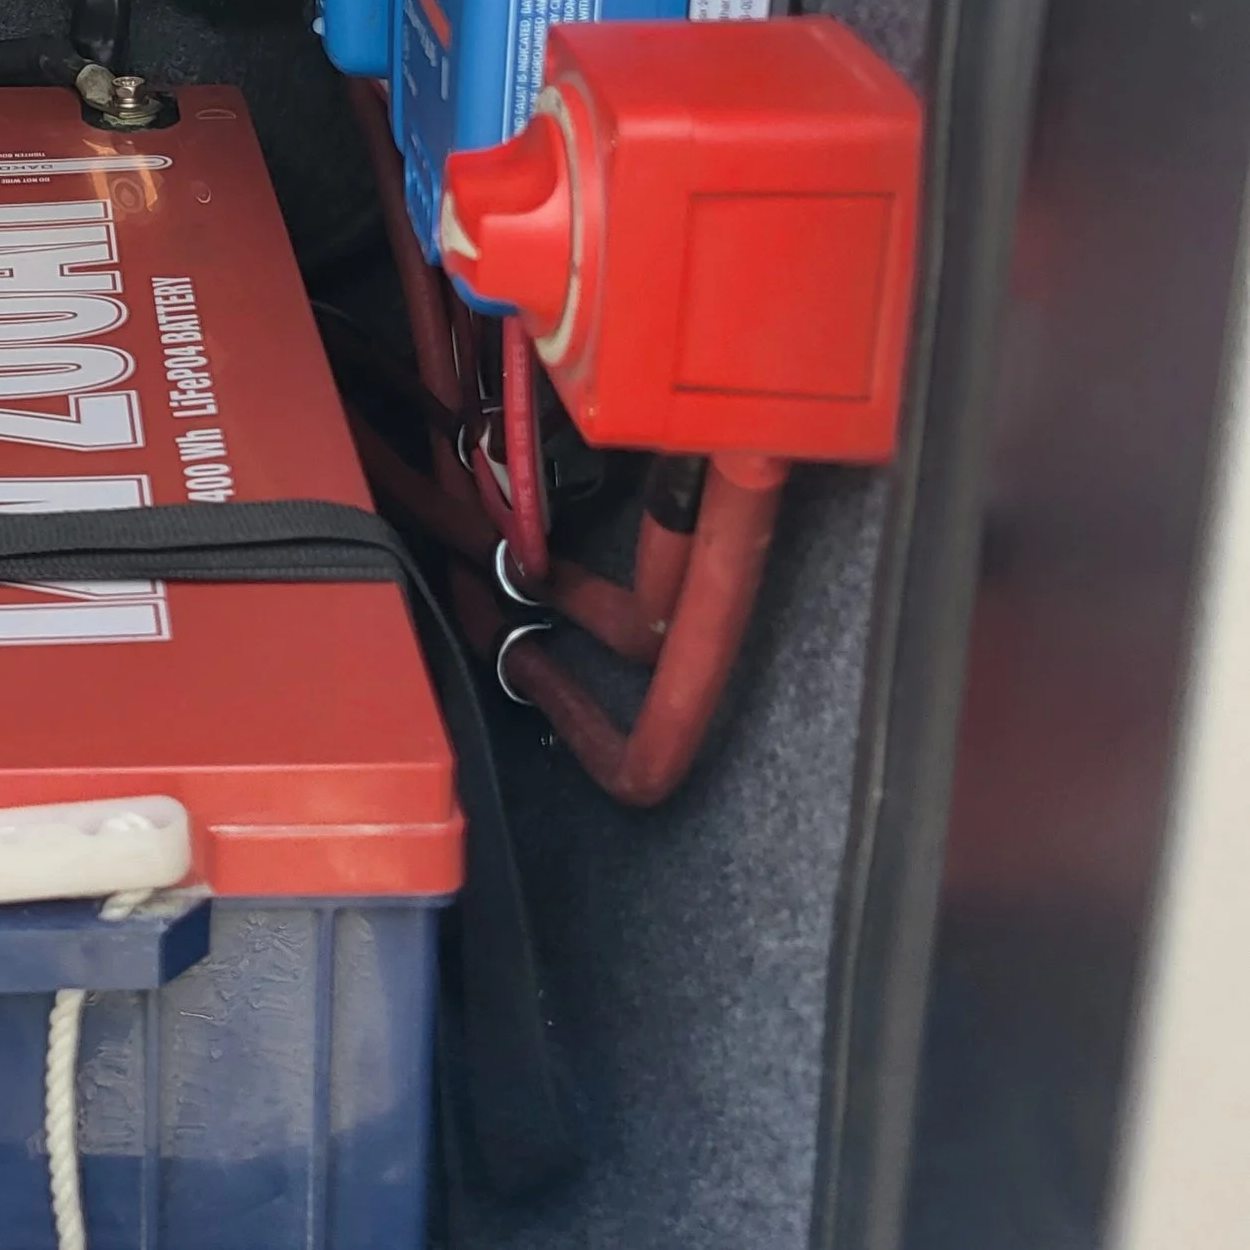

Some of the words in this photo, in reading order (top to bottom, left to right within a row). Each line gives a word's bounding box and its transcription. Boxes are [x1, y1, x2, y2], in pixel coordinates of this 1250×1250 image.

[518, 17, 532, 71] INDICATED,
[532, 17, 546, 88] UNGROUNDED
[516, 74, 527, 83] IS
[514, 85, 527, 115] FAULT
[151, 275, 203, 345] BATTERY
[174, 427, 228, 462] Wh
[182, 462, 235, 503] 400
